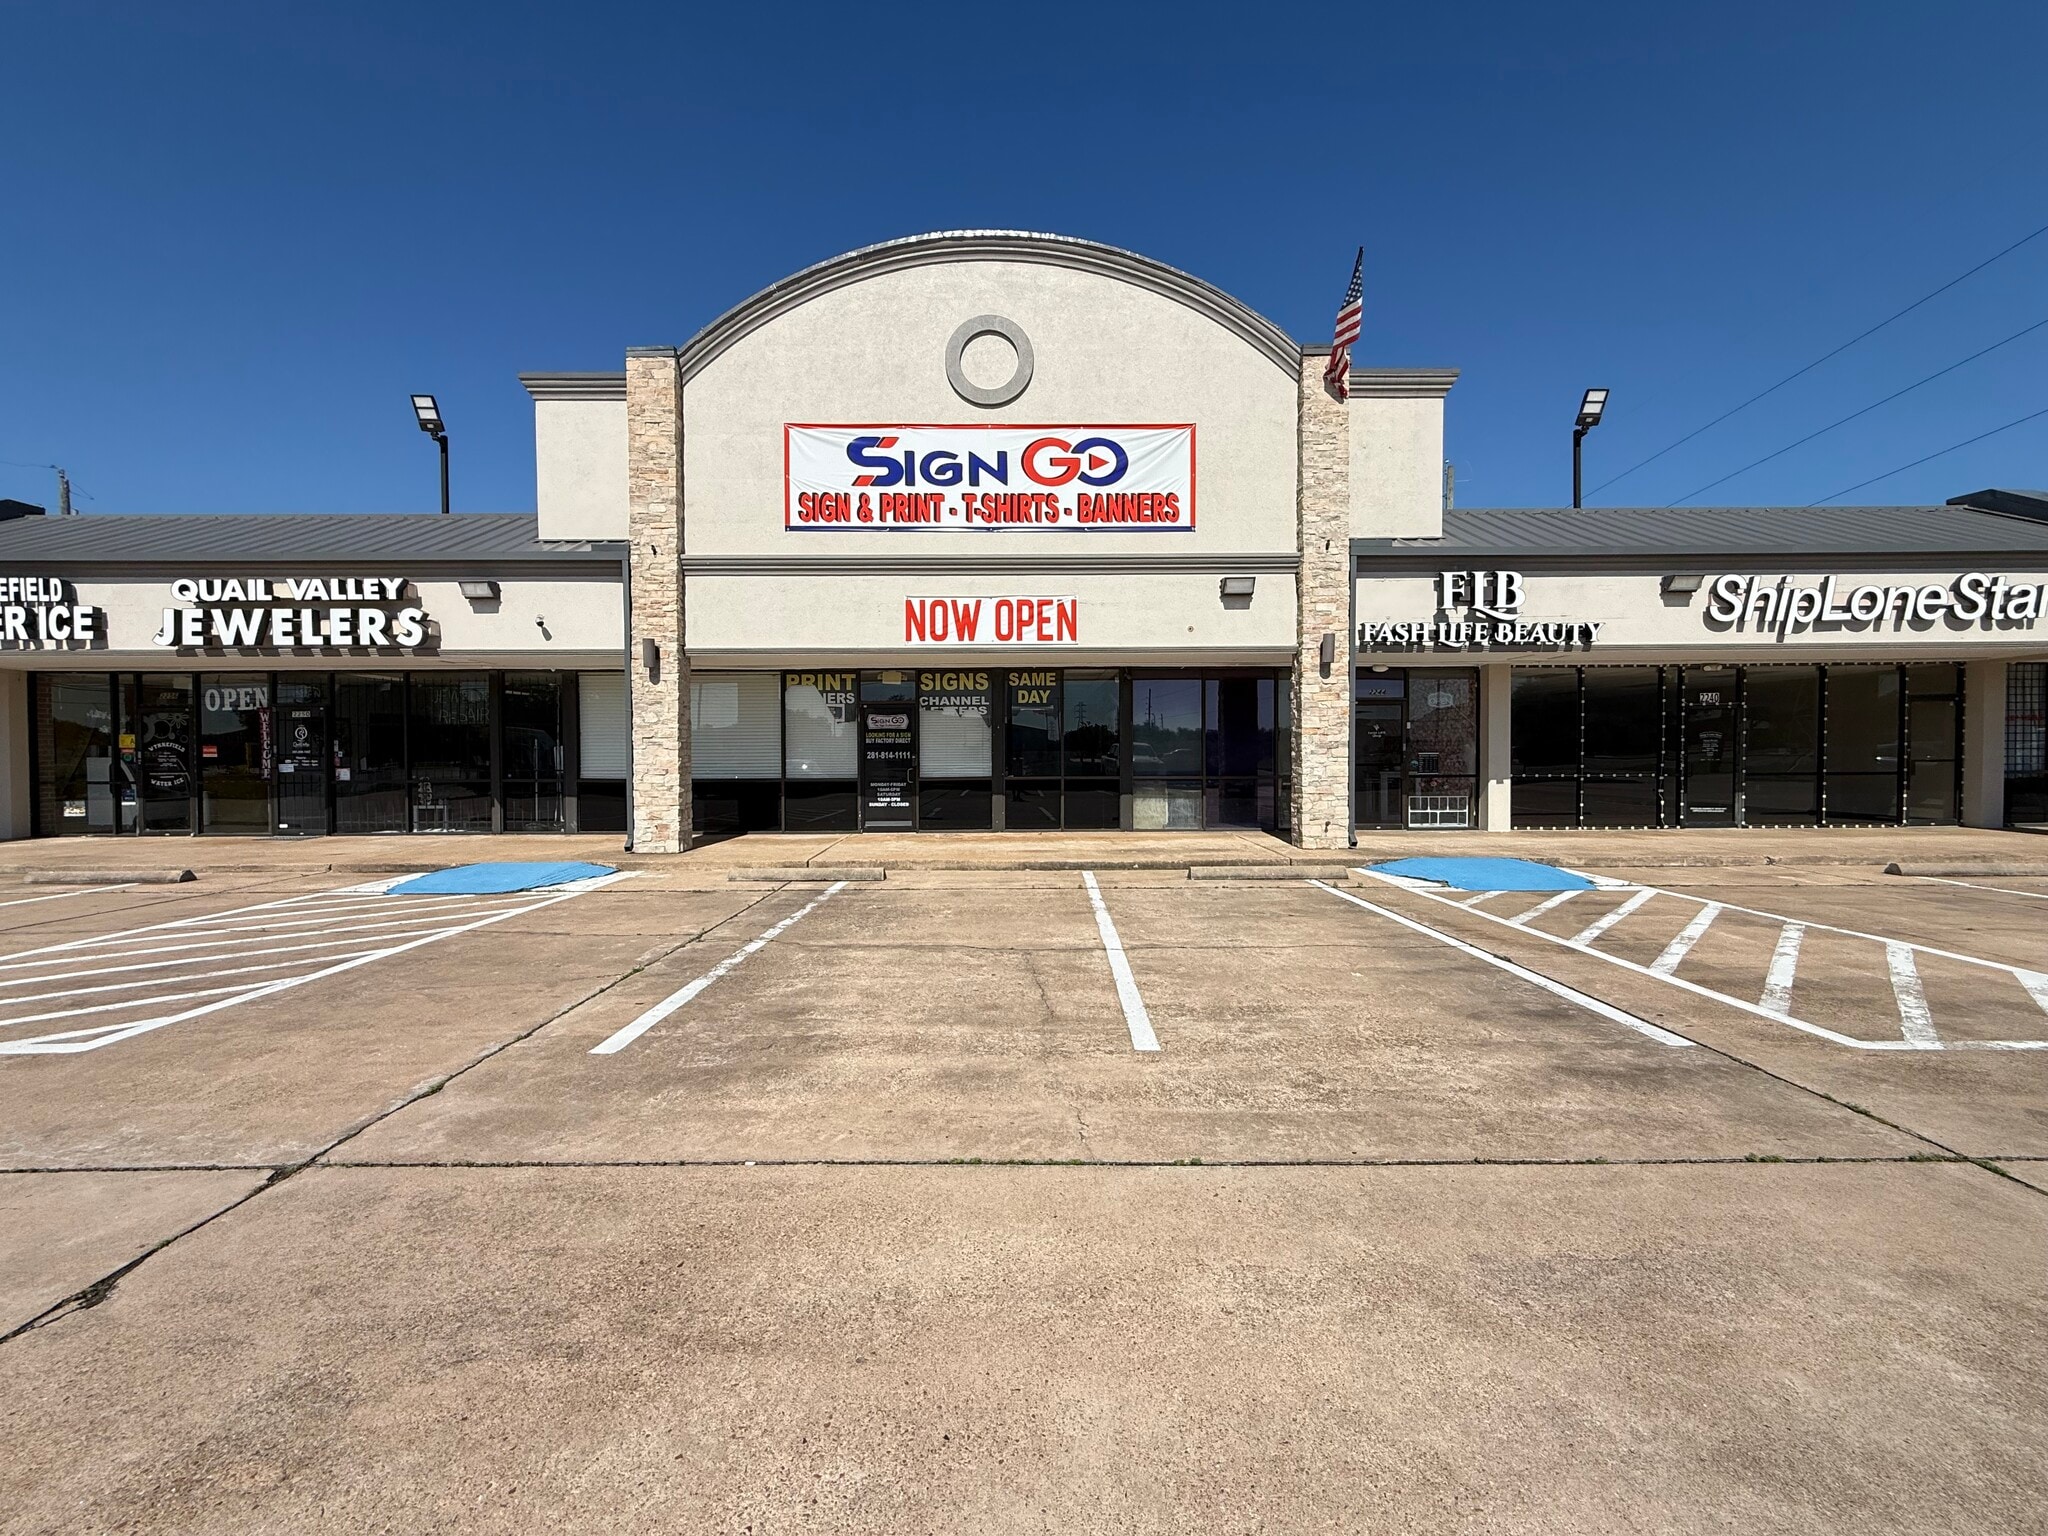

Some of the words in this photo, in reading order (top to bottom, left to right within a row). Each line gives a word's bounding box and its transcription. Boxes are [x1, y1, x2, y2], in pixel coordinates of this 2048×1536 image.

[846, 436, 1008, 487] SIGN
[1021, 437, 1129, 487] GO
[798, 492, 851, 523] SIGN
[859, 492, 875, 523] &
[879, 492, 946, 523] PRINT
[962, 492, 1060, 523] T-SHIRTS
[1077, 492, 1180, 523] BANNERS
[170, 578, 273, 603] QUAIL
[286, 577, 405, 601] VALLEY
[1438, 571, 1527, 621] FLB
[1709, 572, 2048, 635] ShipLoneStar
[0, 605, 29, 640] R
[38, 605, 94, 640] ICE
[152, 607, 425, 647] JEWELERS
[905, 599, 982, 641] NOW
[995, 599, 1077, 641] OPEN
[1362, 622, 1432, 643] FASH
[1438, 622, 1490, 647] LIFE
[1495, 622, 1606, 646] BEAUTY
[786, 674, 857, 690] PRINT
[920, 673, 989, 691] SIGNS
[1008, 672, 1057, 687] SAME
[205, 687, 268, 711] OPEN
[919, 696, 990, 706] CHANNEL
[1018, 690, 1051, 704] DAY
[1700, 693, 1720, 703] 2240
[260, 711, 272, 779] WELCOME
